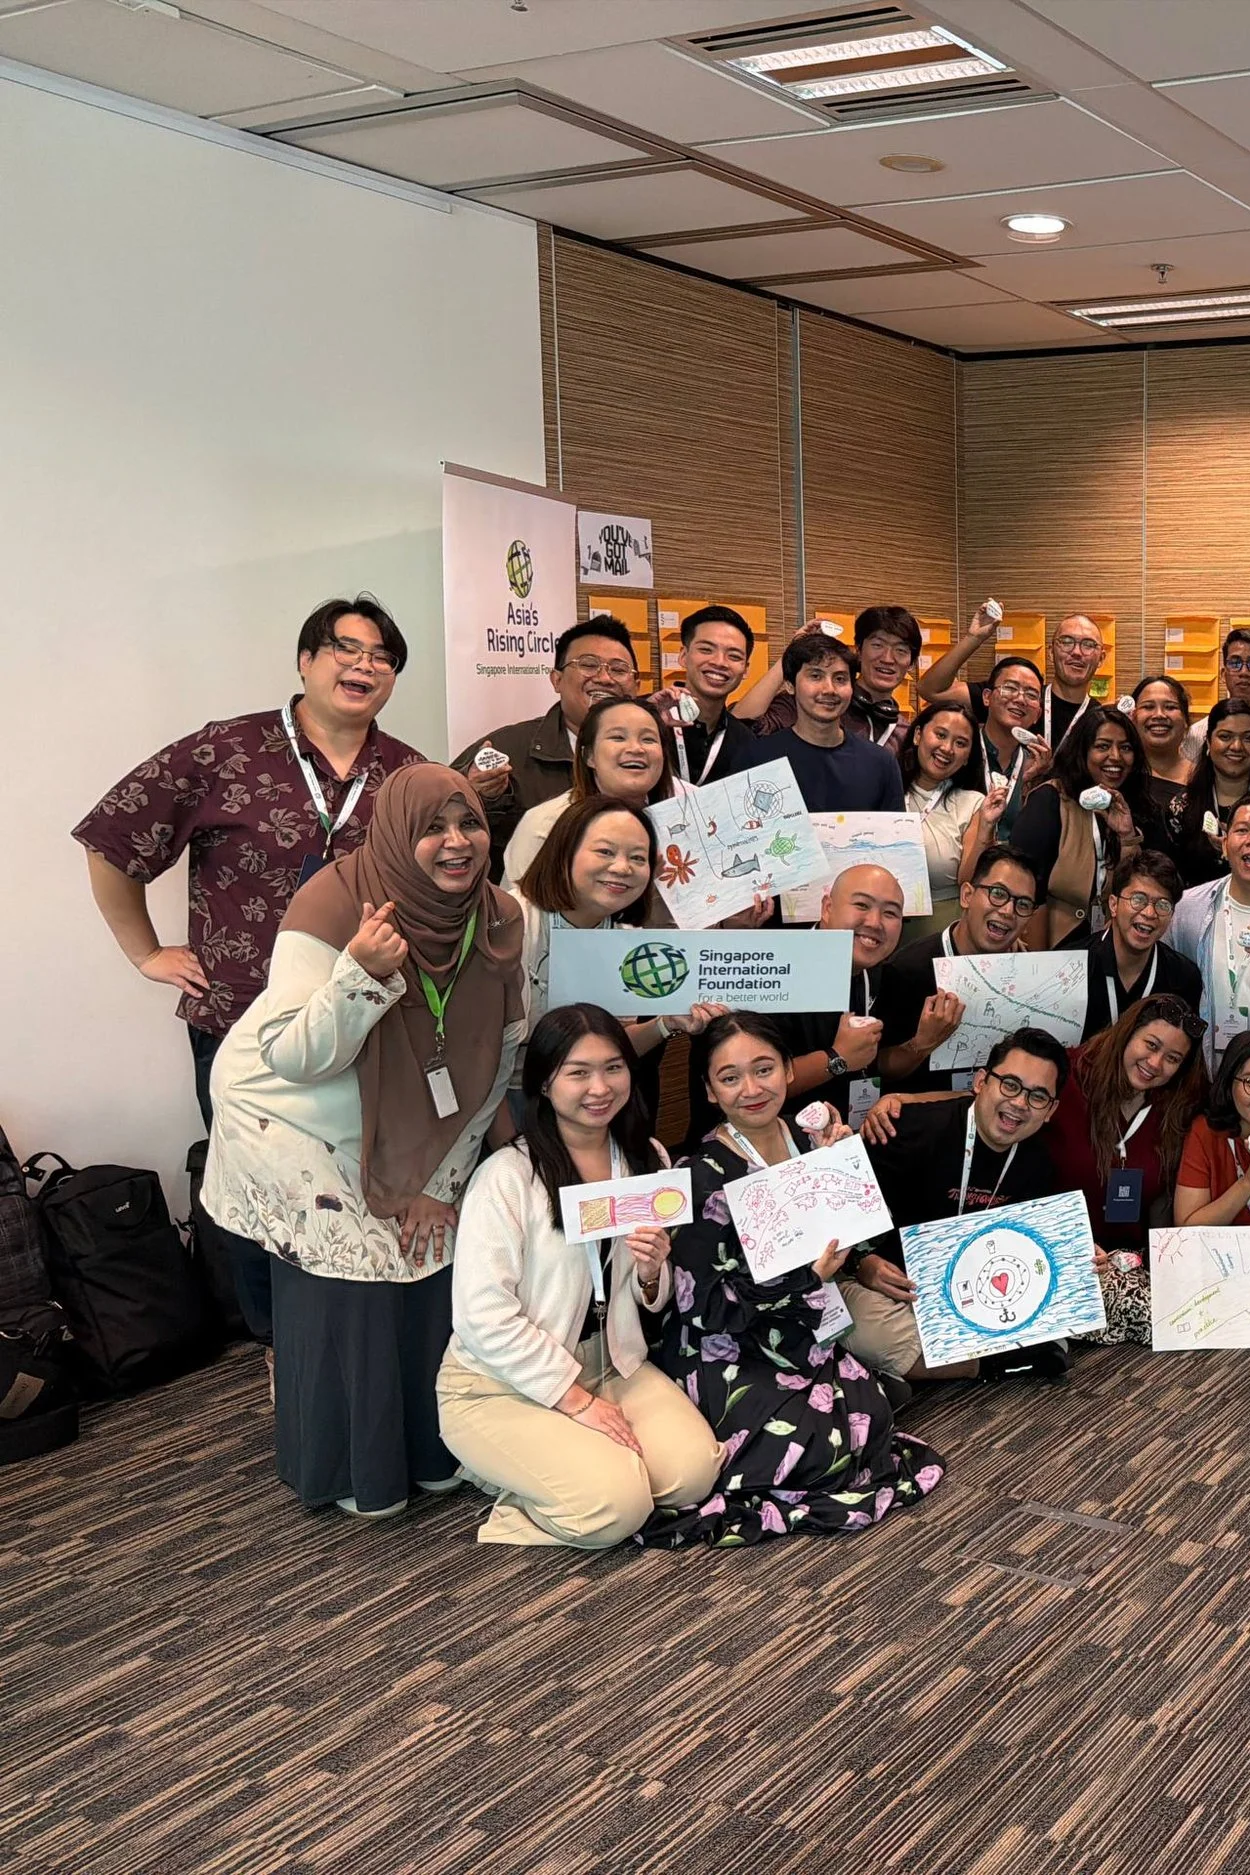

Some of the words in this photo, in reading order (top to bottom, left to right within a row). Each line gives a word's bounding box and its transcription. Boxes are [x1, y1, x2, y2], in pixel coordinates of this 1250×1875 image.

[605, 542, 627, 559] GOT
[604, 557, 631, 576] MAIL
[507, 602, 539, 626] Asia's
[487, 628, 525, 658] Rising
[476, 664, 506, 677] Singapore
[507, 664, 540, 675] International
[699, 949, 774, 964] Singapore
[698, 963, 791, 976] International
[698, 977, 781, 990] Foundation
[716, 994, 723, 1002] a
[726, 992, 757, 1003] better
[760, 991, 789, 1002] world
